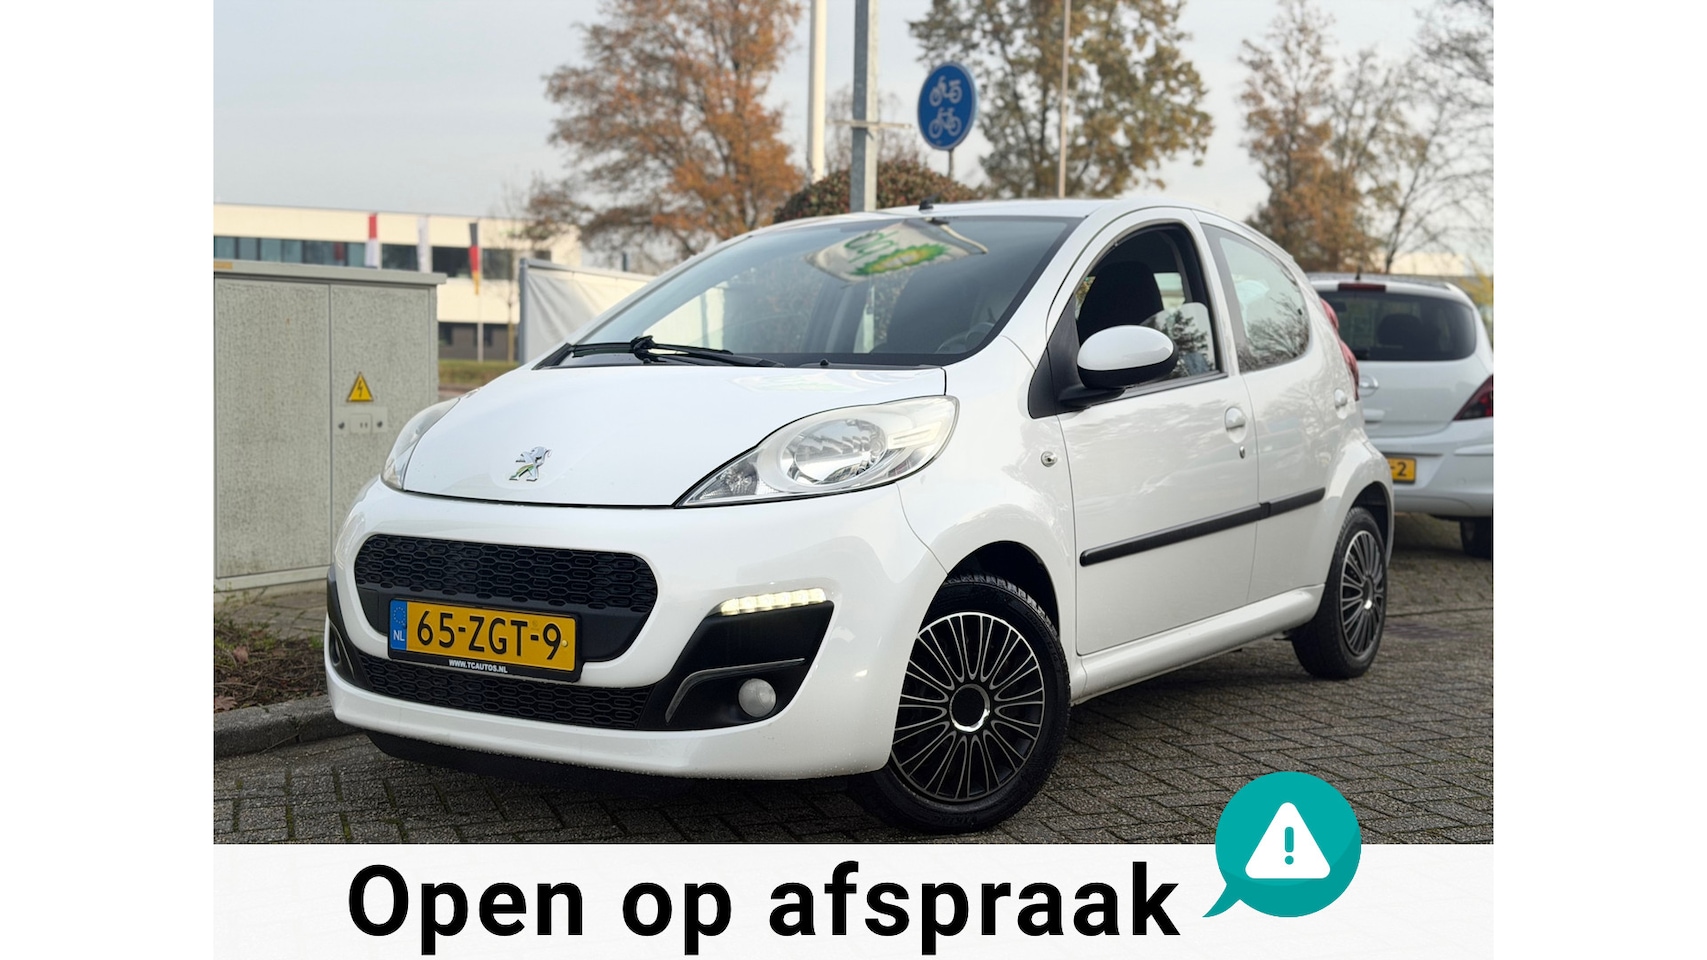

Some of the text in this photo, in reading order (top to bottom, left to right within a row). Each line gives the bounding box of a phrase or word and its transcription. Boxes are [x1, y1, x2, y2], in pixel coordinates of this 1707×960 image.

[393, 629, 405, 642] NL
[417, 610, 562, 660] 65-ZGT-9
[448, 658, 508, 674] WWW.TCAUTOS.NL
